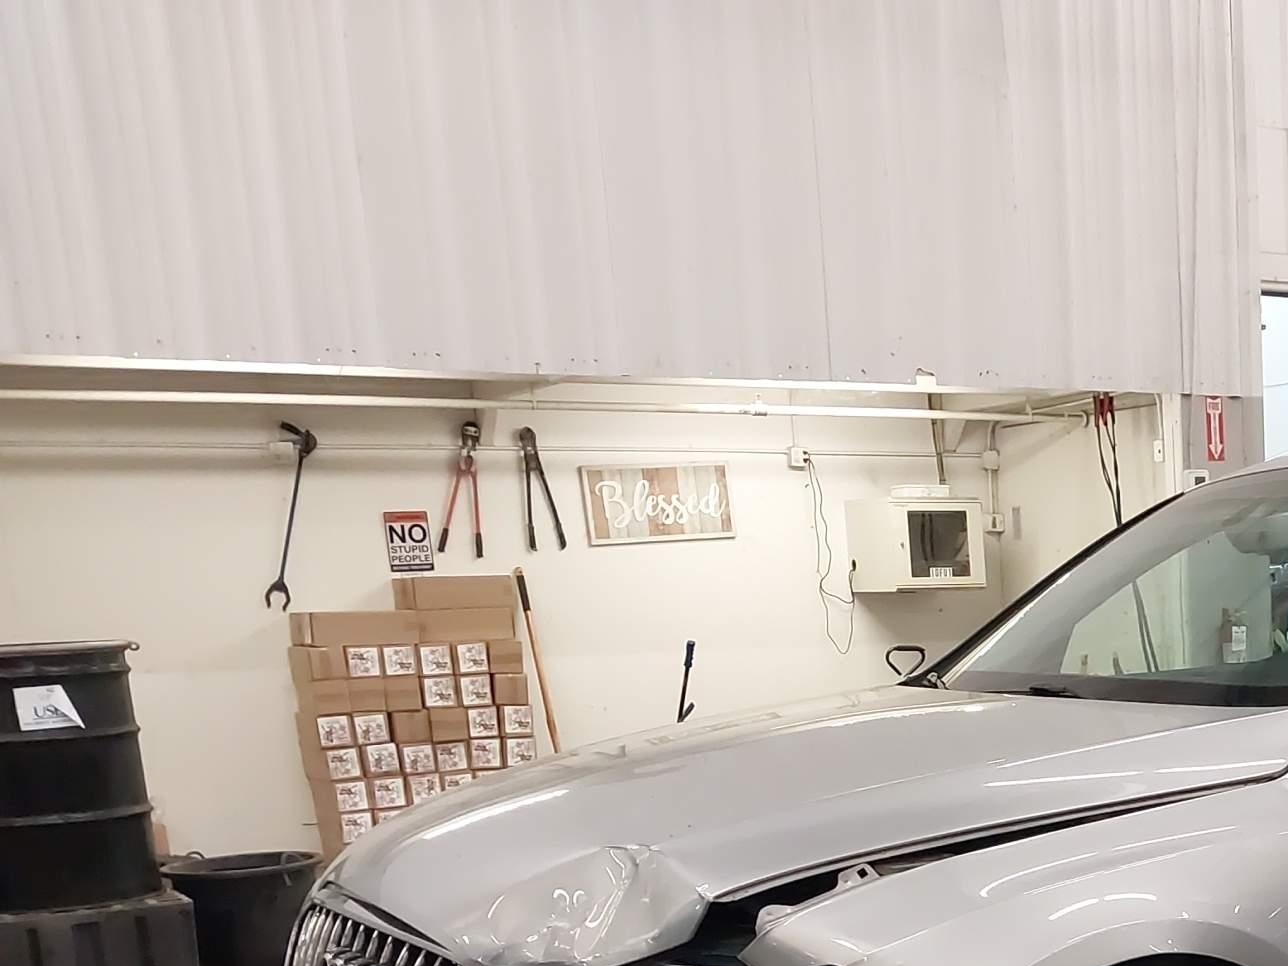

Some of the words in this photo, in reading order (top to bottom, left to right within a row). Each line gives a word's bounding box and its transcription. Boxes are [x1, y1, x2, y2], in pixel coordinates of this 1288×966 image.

[595, 480, 726, 528] Blessed
[388, 523, 427, 544] NO
[390, 545, 429, 554] STUPID
[391, 554, 431, 563] PEOPLE
